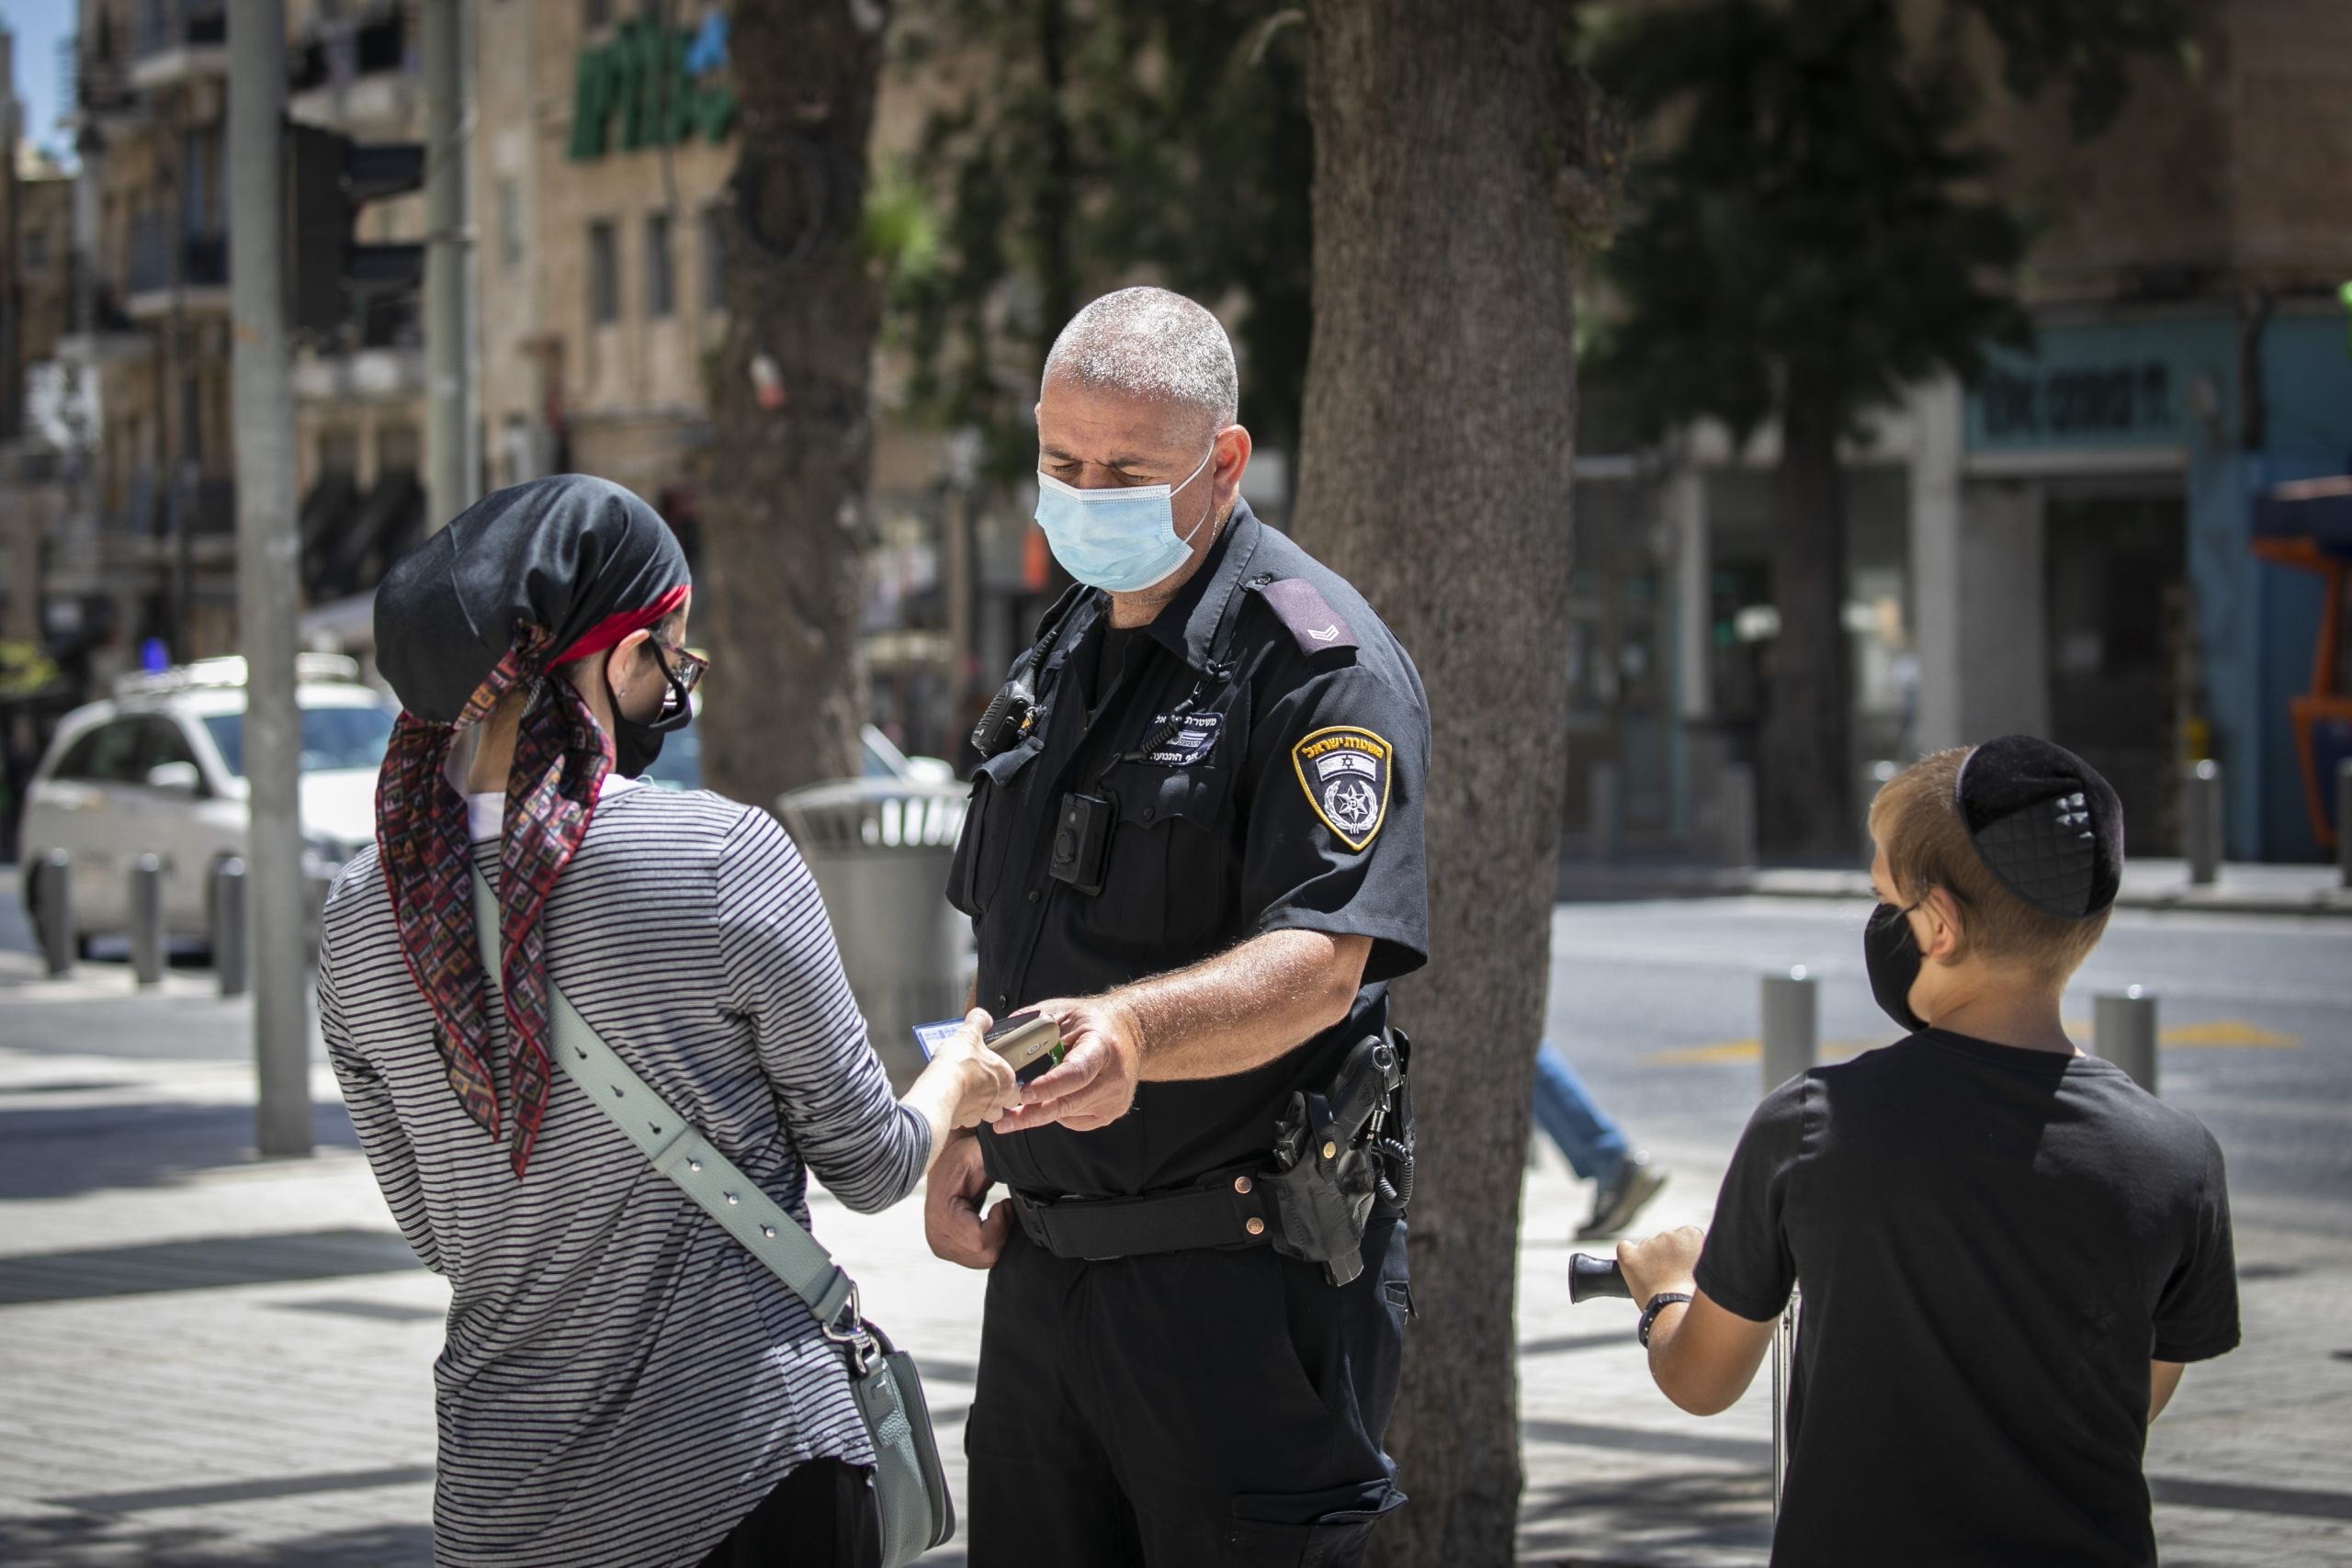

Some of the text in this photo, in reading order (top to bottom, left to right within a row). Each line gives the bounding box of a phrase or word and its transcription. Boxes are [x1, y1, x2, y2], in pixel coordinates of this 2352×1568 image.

[1184, 716, 1217, 727] משטרת
[1301, 736, 1385, 760] משטרת ישראל
